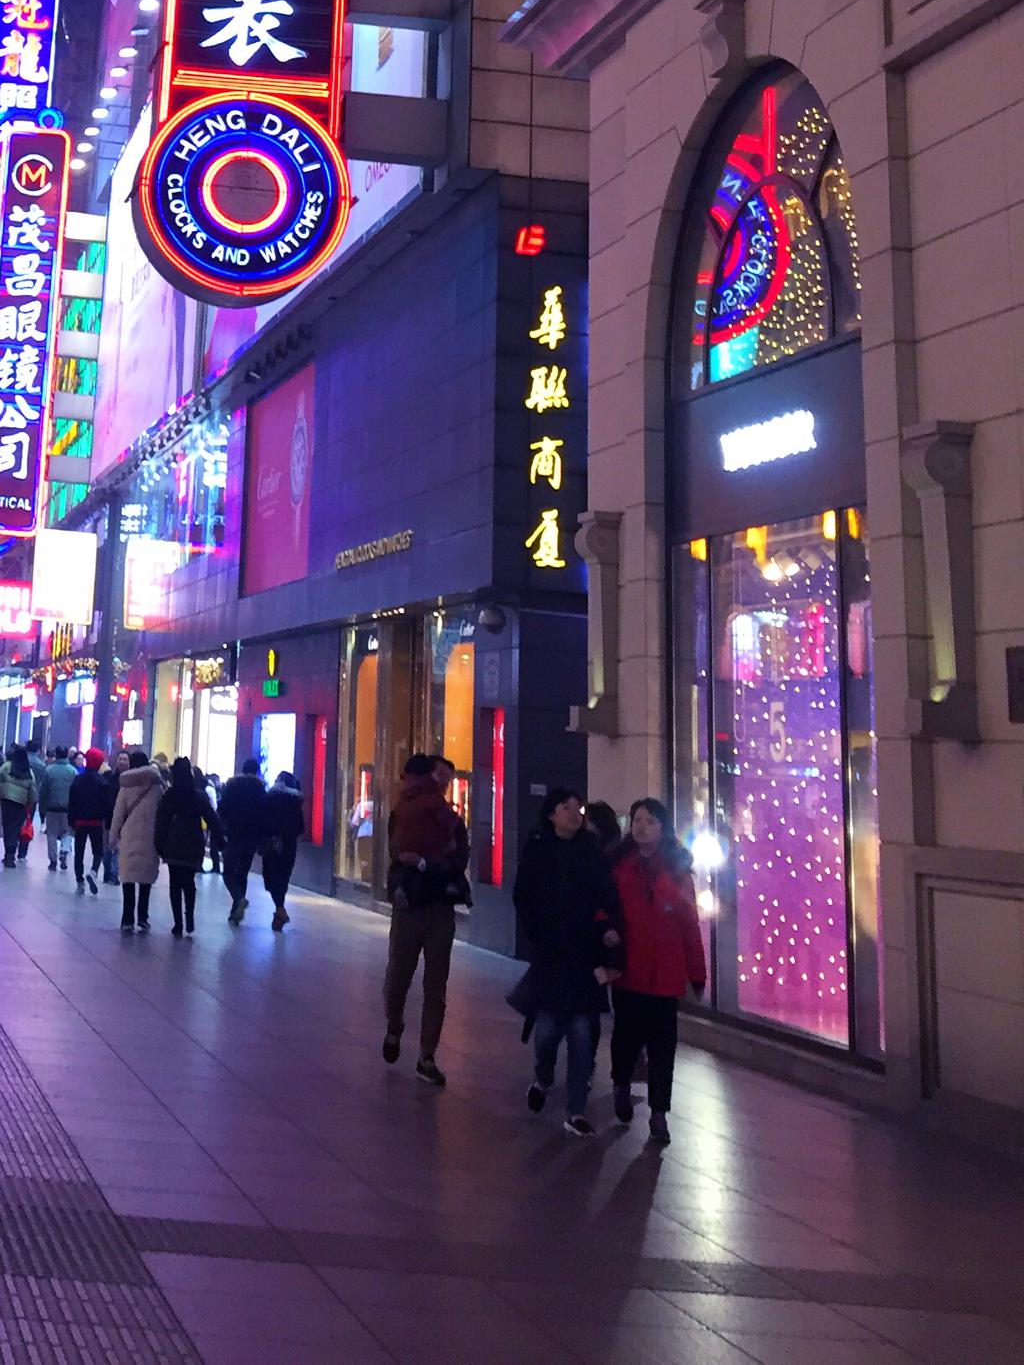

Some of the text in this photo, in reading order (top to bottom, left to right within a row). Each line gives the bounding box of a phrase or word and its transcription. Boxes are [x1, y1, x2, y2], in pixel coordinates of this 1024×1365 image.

[174, 110, 321, 173] HENG DALI
[167, 173, 324, 266] CLOCKS AND WATCHES
